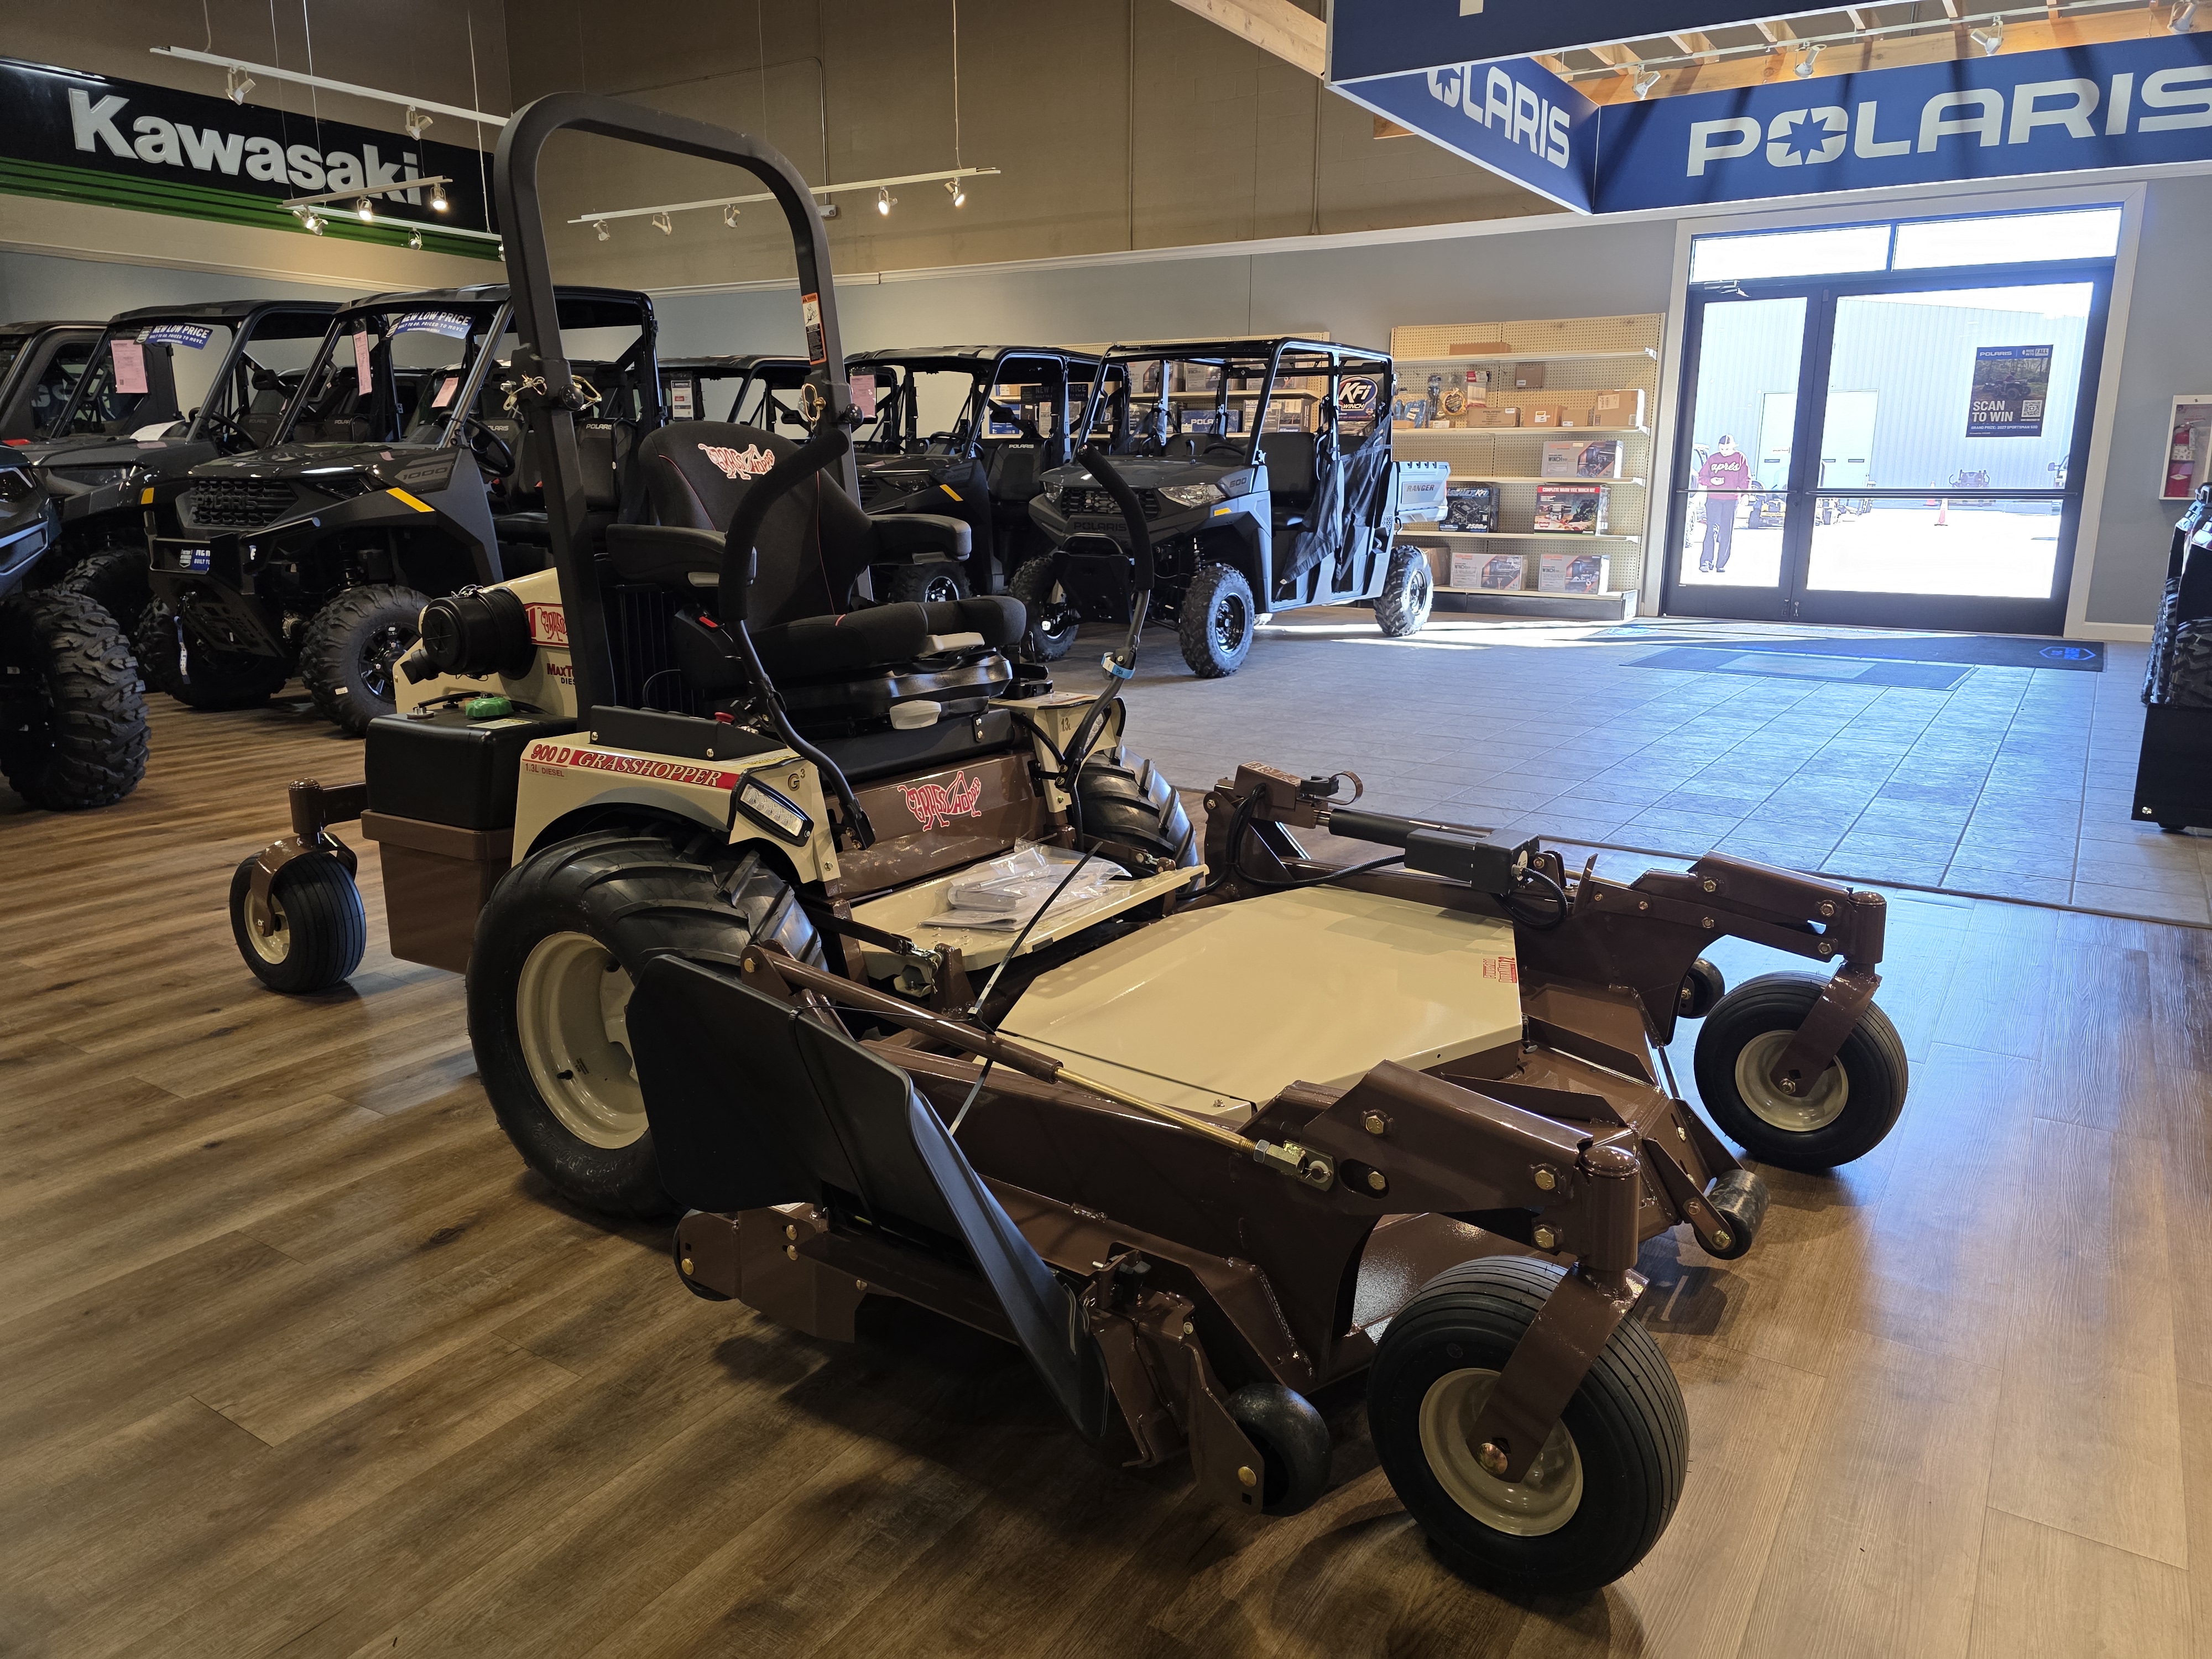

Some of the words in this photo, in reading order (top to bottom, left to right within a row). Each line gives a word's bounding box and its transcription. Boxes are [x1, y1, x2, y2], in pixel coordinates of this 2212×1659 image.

[1427, 64, 1571, 170] OLARIS
[1686, 65, 2212, 177] POLARIS
[68, 88, 422, 205] Kawasaki
[401, 312, 419, 323] NEW
[418, 311, 439, 320] LOW
[438, 311, 471, 326] PRICE
[153, 325, 169, 333] NEW
[166, 325, 182, 333] LOW
[182, 325, 209, 339] PRICE
[1973, 400, 2005, 411] SCAN
[1972, 412, 1987, 422] TO
[1990, 411, 2013, 422] WIN
[403, 467, 448, 480] 1000
[1073, 521, 1127, 532] POLARIS
[179, 642, 187, 676] POLARIS
[546, 663, 574, 677] MAXT
[525, 763, 539, 774] 1.3L
[541, 766, 565, 778] DIESEL
[530, 744, 556, 761] 900
[557, 748, 571, 764] D
[577, 753, 723, 787] GRASSHOPPER
[900, 771, 981, 828] GRASSHOPPER
